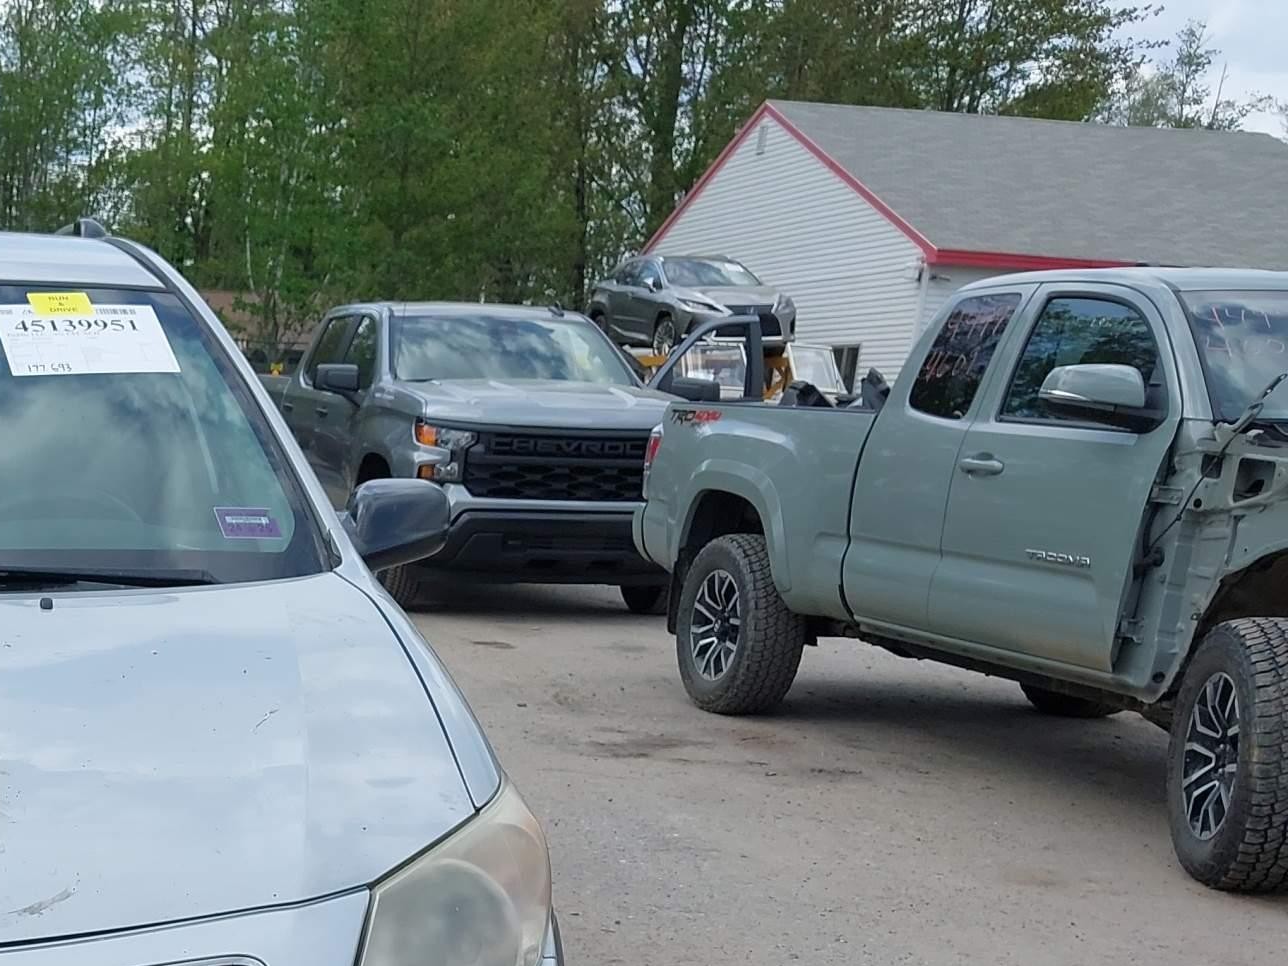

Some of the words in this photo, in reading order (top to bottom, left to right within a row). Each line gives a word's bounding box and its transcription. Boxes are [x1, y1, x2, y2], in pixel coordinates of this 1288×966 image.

[15, 319, 138, 332] 45139951
[490, 437, 644, 455] CHEVROL
[1024, 548, 1091, 567] TACOMA
